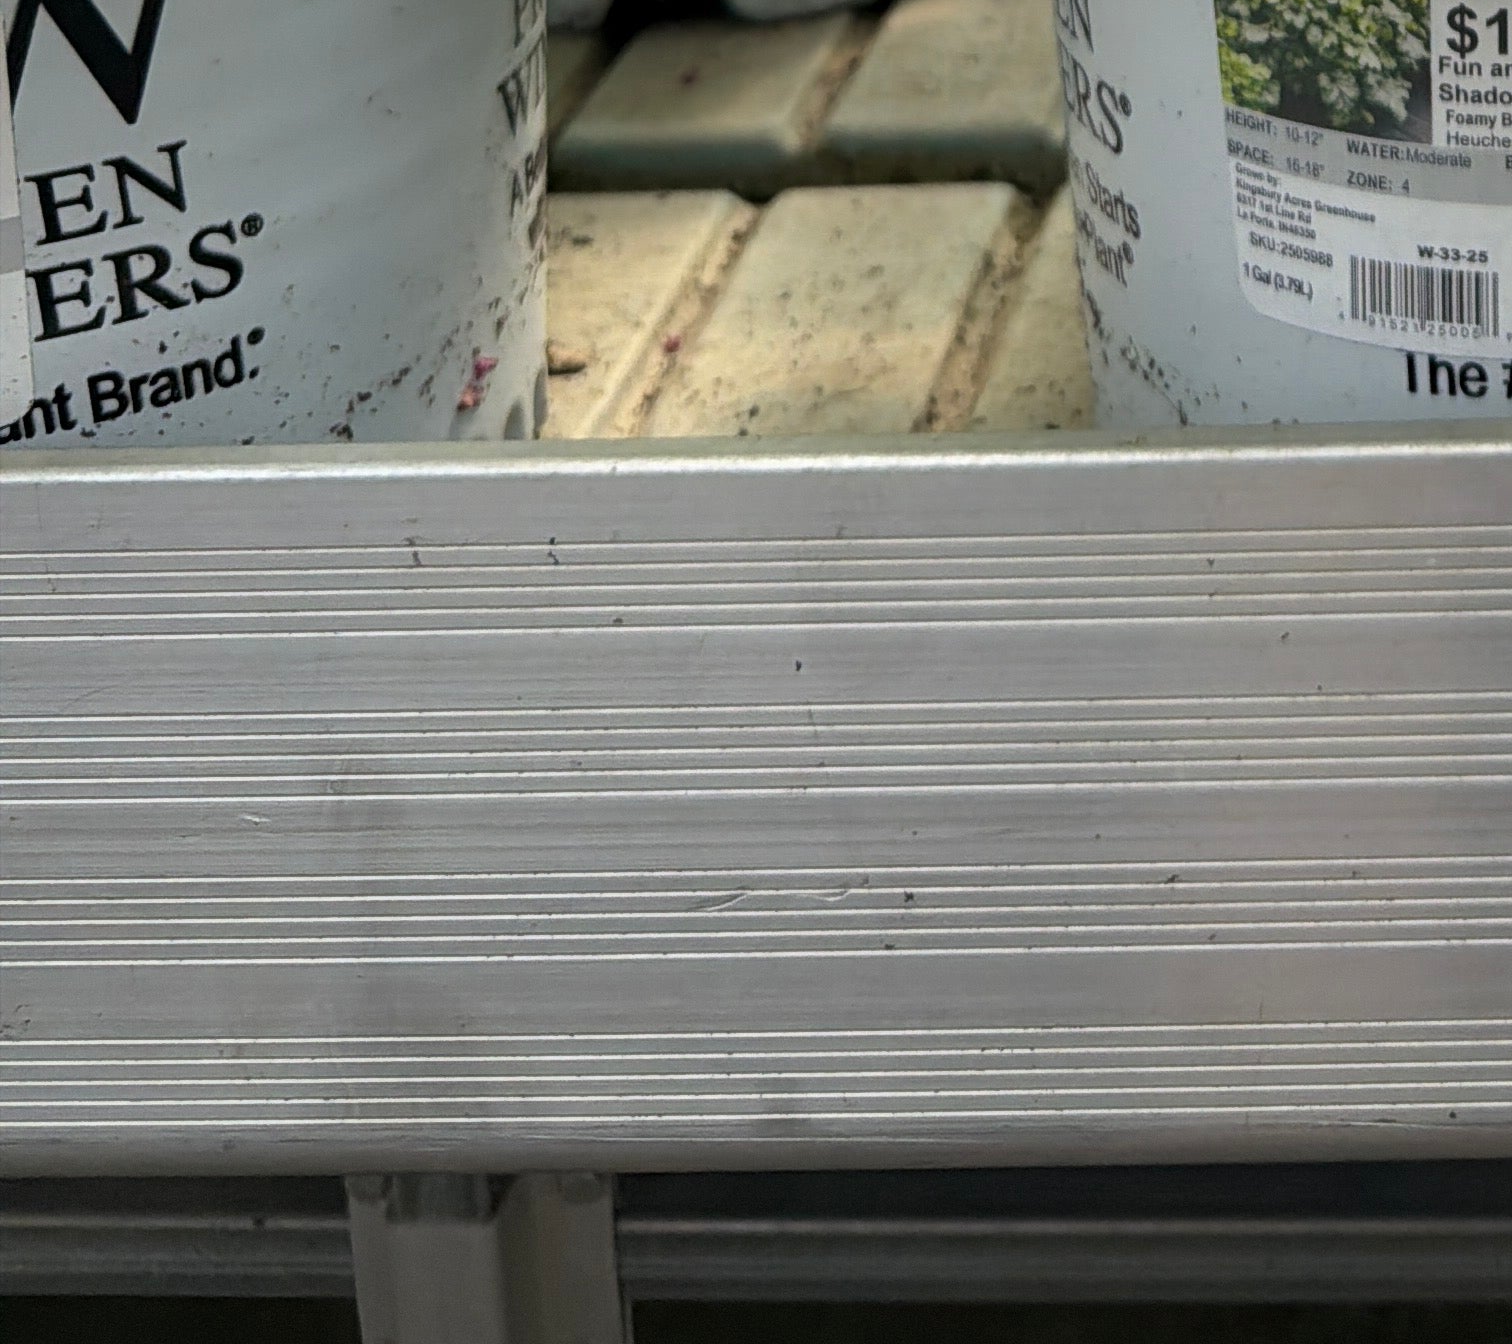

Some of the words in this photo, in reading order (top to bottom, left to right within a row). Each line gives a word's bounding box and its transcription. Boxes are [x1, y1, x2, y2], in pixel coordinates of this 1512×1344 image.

[1438, 55, 1482, 78] Fun
[1225, 107, 1277, 137] HEIGHT:
[1446, 110, 1497, 131] Foamy
[1226, 138, 1274, 164] SPACE:
[1406, 146, 1473, 169] Moderate
[1346, 169, 1392, 191] ZONE:
[1402, 178, 1410, 194] 4
[1236, 176, 1282, 204] Kingsbury
[1284, 192, 1312, 210] Acres
[1315, 200, 1376, 223] Greenhouse
[1298, 210, 1312, 225] Rd
[1417, 244, 1489, 263] W-33-25
[1252, 265, 1272, 286] Gal
[1274, 272, 1314, 302] (3.79L)
